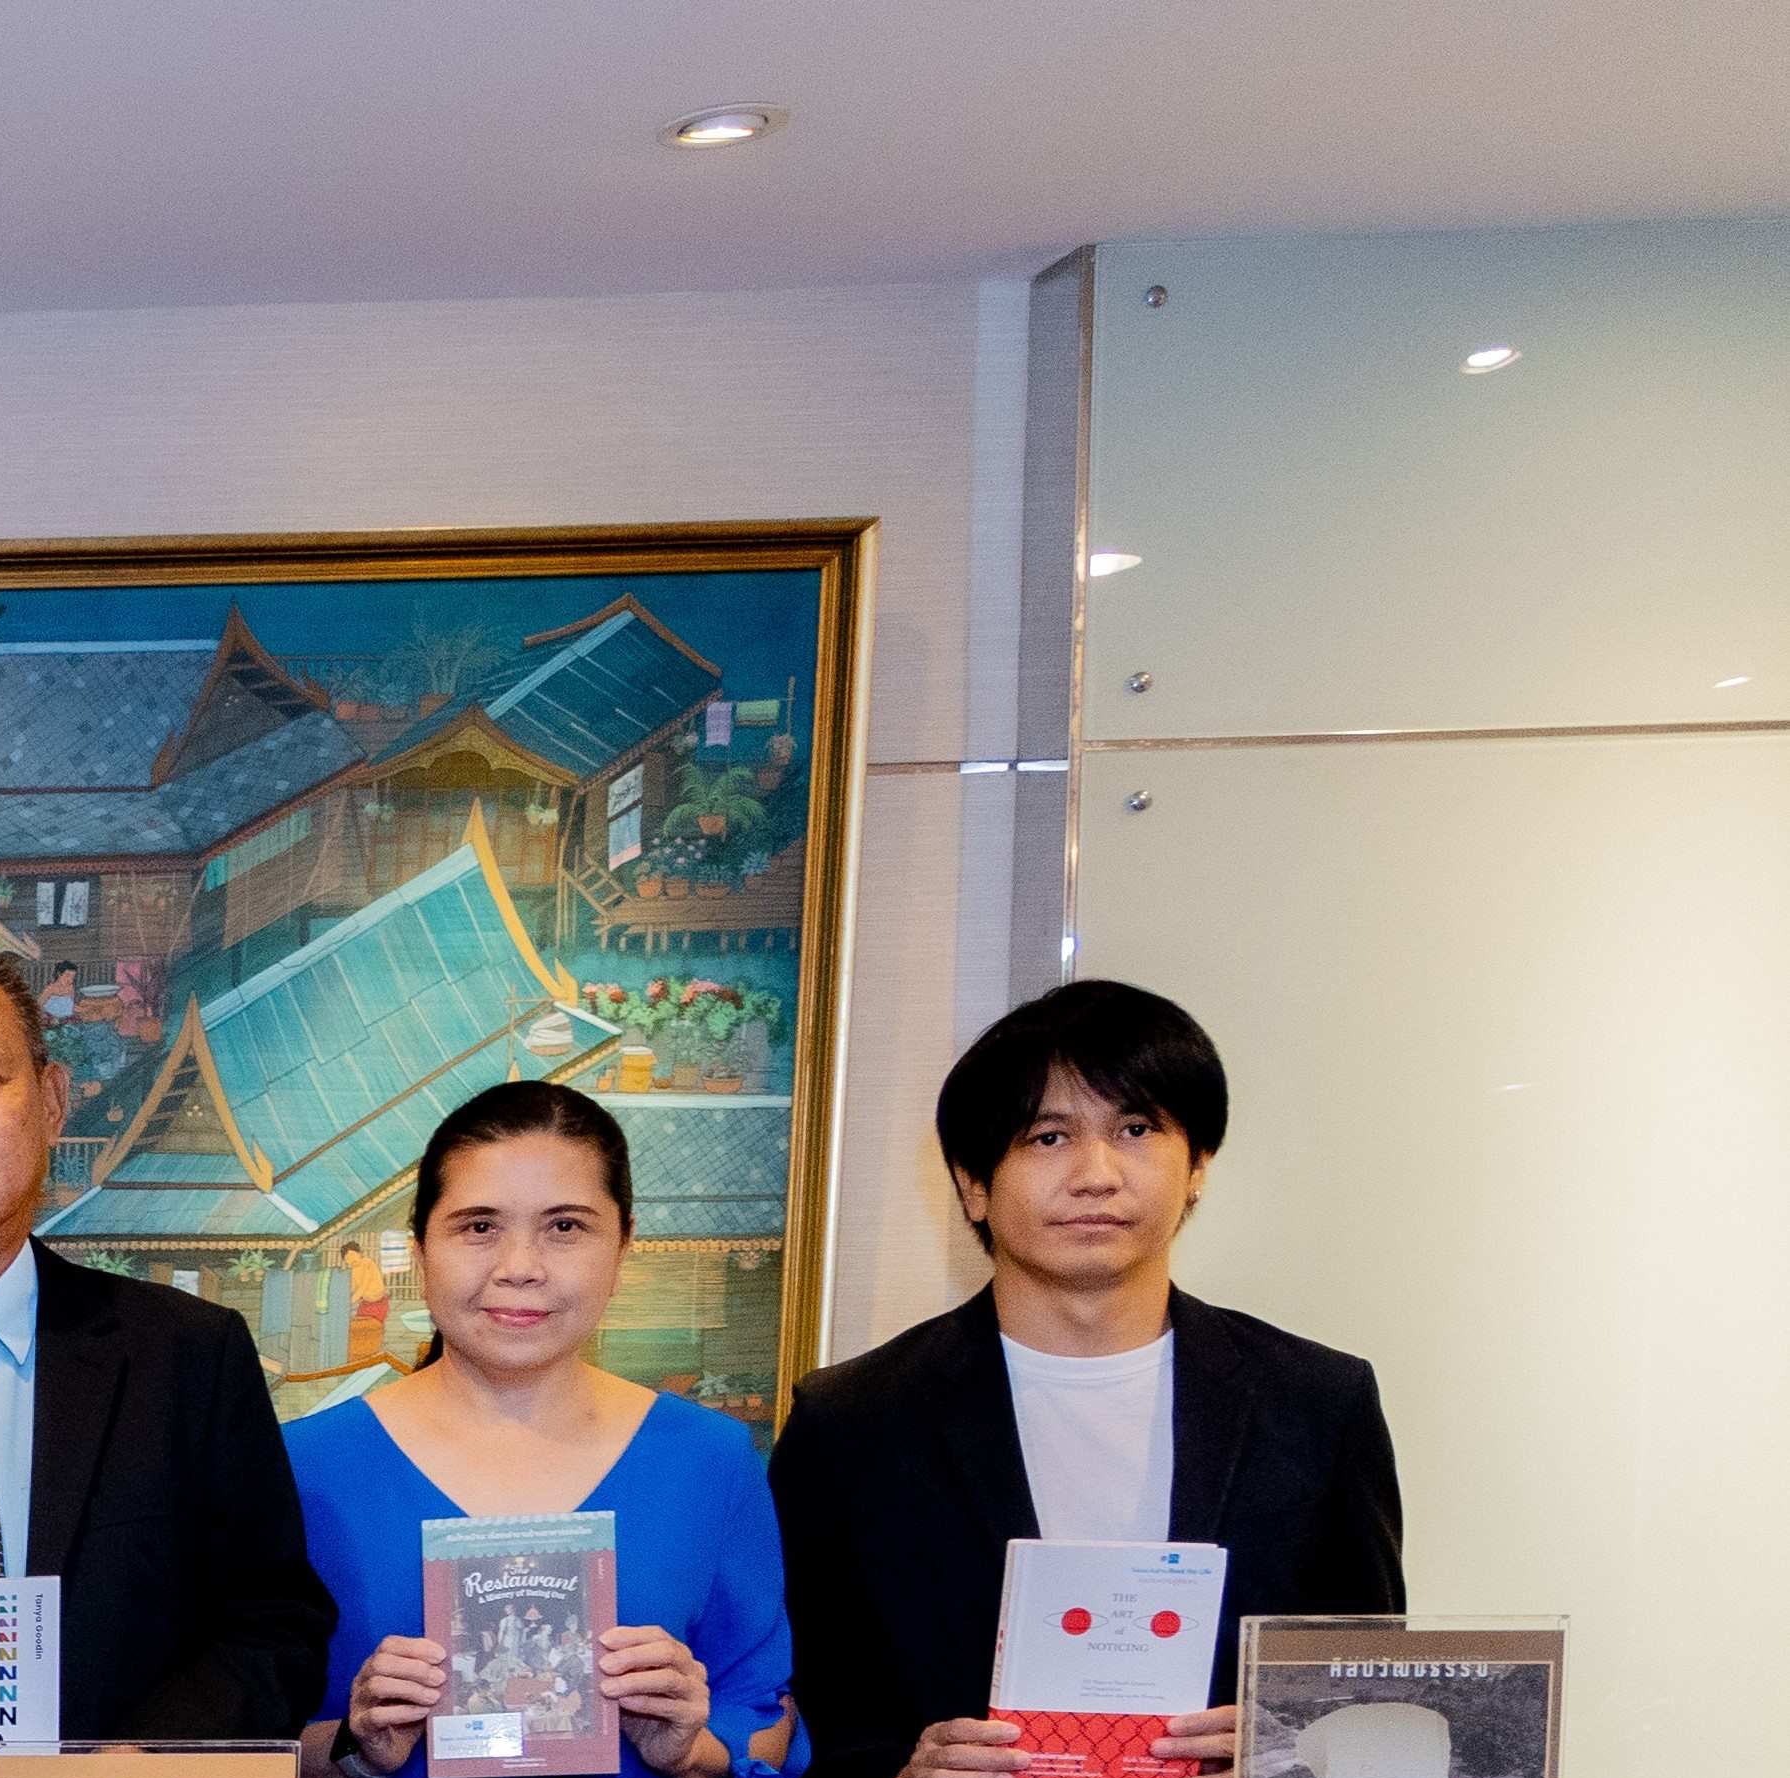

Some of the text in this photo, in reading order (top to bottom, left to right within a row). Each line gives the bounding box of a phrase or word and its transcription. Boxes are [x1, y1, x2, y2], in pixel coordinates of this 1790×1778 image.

[463, 1572, 579, 1597] Restaurant
[33, 1593, 44, 1660] Tanya Goodin
